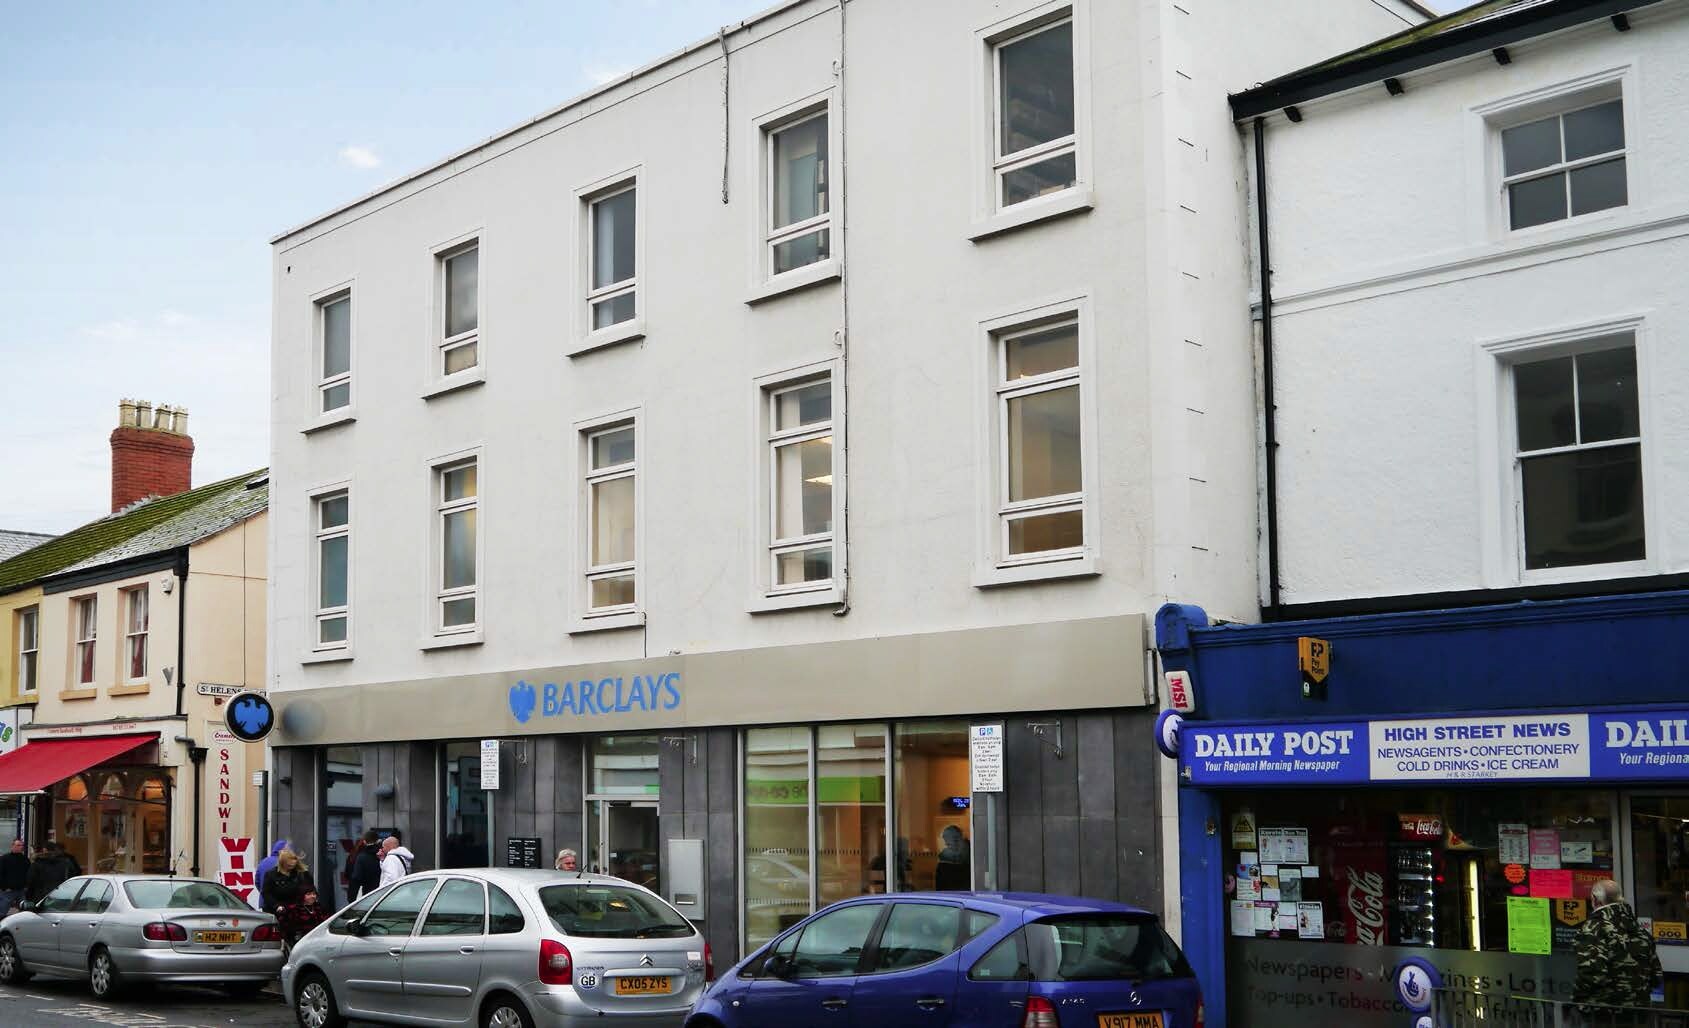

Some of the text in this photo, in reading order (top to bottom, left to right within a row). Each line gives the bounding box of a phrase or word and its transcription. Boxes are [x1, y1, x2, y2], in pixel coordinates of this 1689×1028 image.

[543, 672, 681, 717] BARCLAYS
[1384, 722, 1572, 742] HIGH STREET NEWS
[1195, 730, 1354, 758] DAILY POST
[1377, 743, 1580, 759] NEWSAGENTS CONFECTIONERY
[1205, 759, 1341, 773] Your Regional Morning Newspaper
[1396, 758, 1560, 772] COLD DRINKS ICE CREAM
[1619, 752, 1642, 765] Your
[218, 748, 232, 839] SANDWI
[1246, 955, 1363, 983] Newspapers
[580, 975, 596, 987] GB
[620, 976, 668, 989] CX05 ZYS
[1135, 1015, 1159, 1028] MMA
